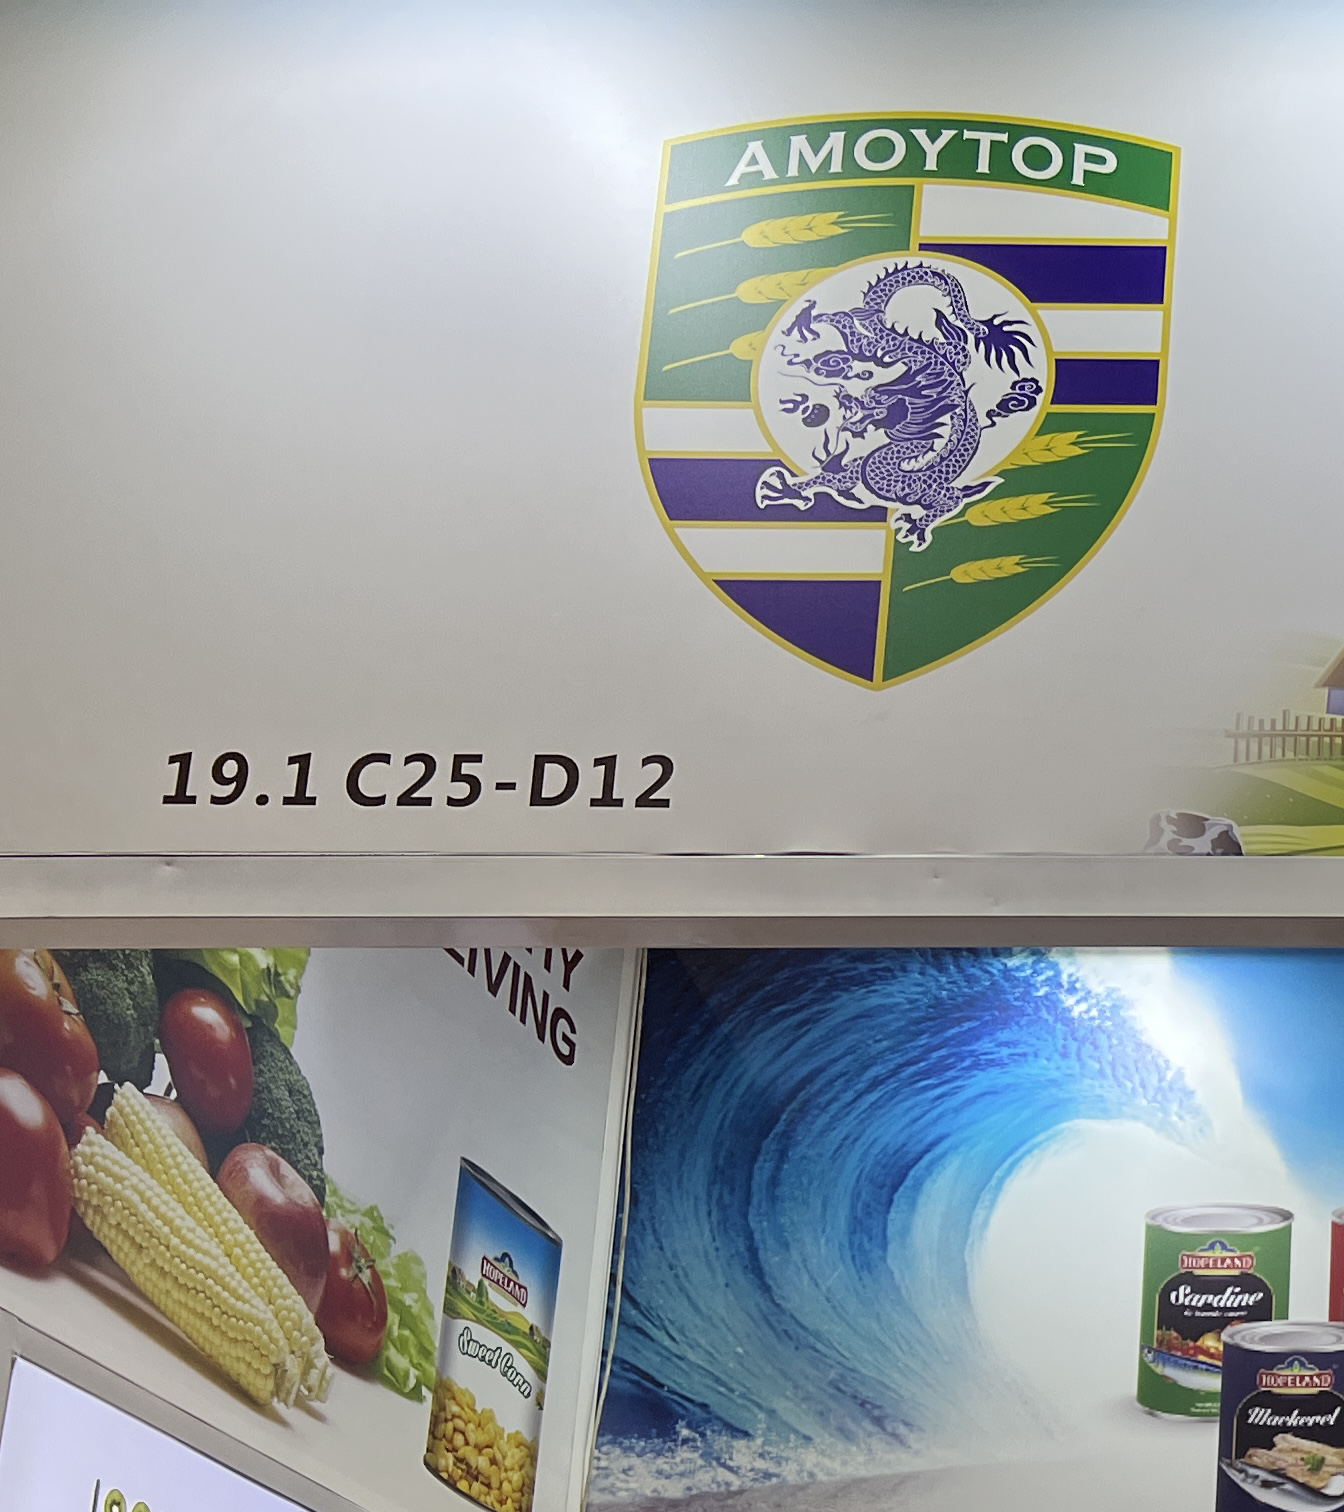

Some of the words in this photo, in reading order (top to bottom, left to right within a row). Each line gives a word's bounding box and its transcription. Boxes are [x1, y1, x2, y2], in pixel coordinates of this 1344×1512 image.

[724, 127, 1120, 188] AMOYTOP
[160, 751, 320, 806] 19.1
[344, 751, 676, 809] C25-D12
[1181, 1252, 1254, 1272] HOPELAND
[482, 1258, 528, 1305] HOPELAND
[1169, 1283, 1265, 1310] Sardine
[458, 1326, 503, 1369] Sweet
[499, 1352, 533, 1399] Corn
[1258, 1370, 1333, 1390] HOPELAND
[1246, 1405, 1340, 1429] Mackerel
